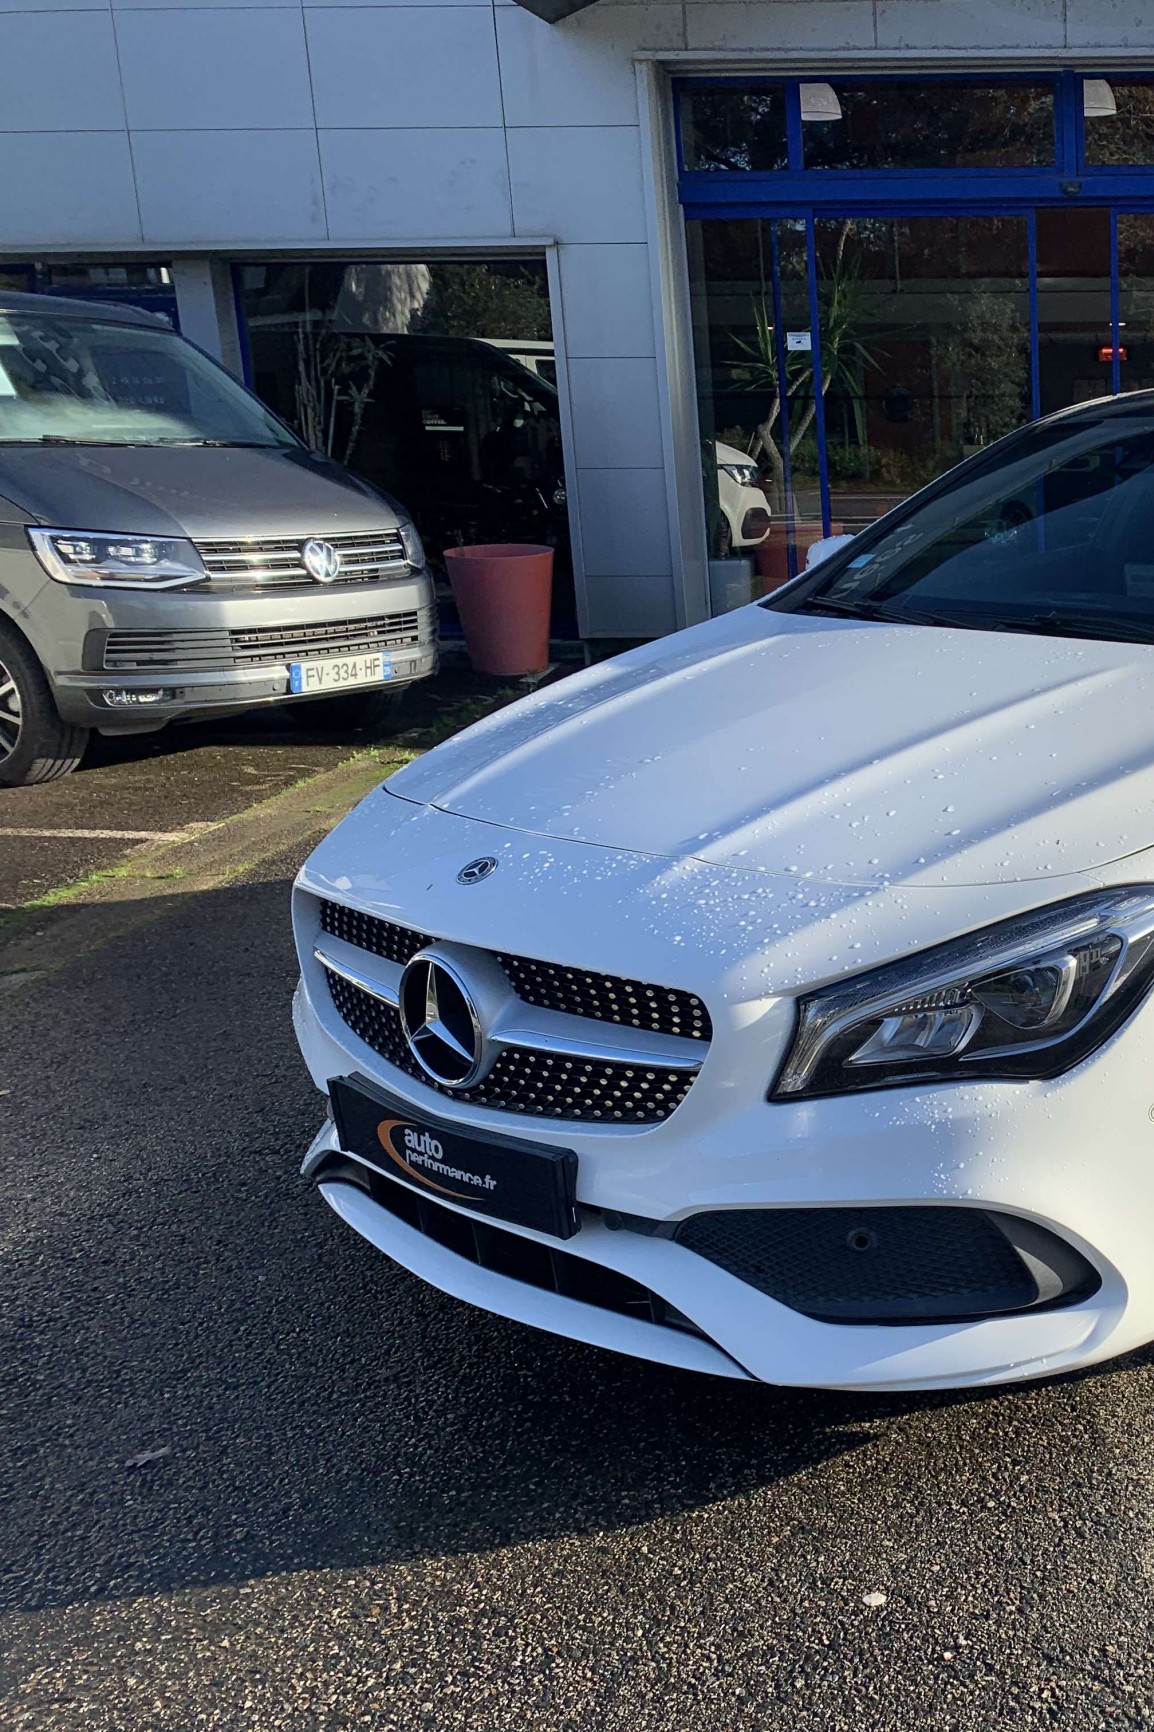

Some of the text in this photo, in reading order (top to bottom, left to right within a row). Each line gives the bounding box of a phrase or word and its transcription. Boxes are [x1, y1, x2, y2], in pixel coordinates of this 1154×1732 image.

[305, 658, 380, 687] FV-334-HF
[404, 1128, 444, 1160] auto
[405, 1149, 498, 1191] performance.fr
